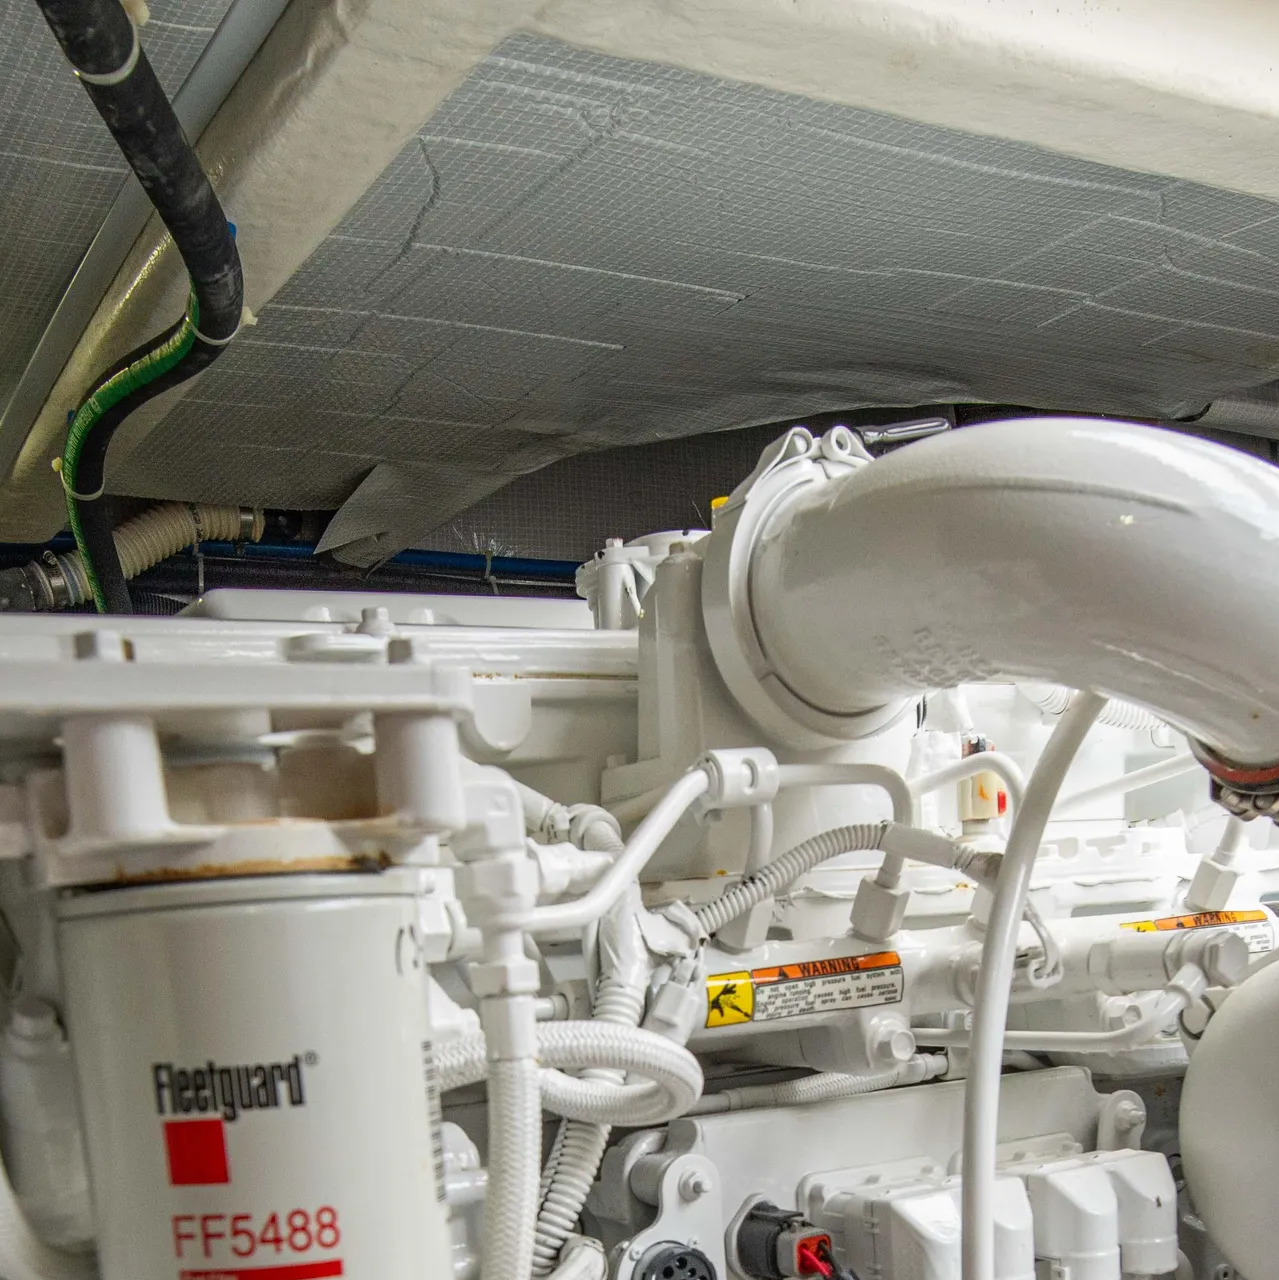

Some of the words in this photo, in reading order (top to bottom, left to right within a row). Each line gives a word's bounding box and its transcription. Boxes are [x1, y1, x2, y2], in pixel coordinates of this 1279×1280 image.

[1193, 911, 1238, 926] WARNING
[798, 957, 859, 977] WARNING
[822, 976, 846, 986] pressure
[866, 972, 885, 980] system
[171, 1206, 342, 1259] FF5488
